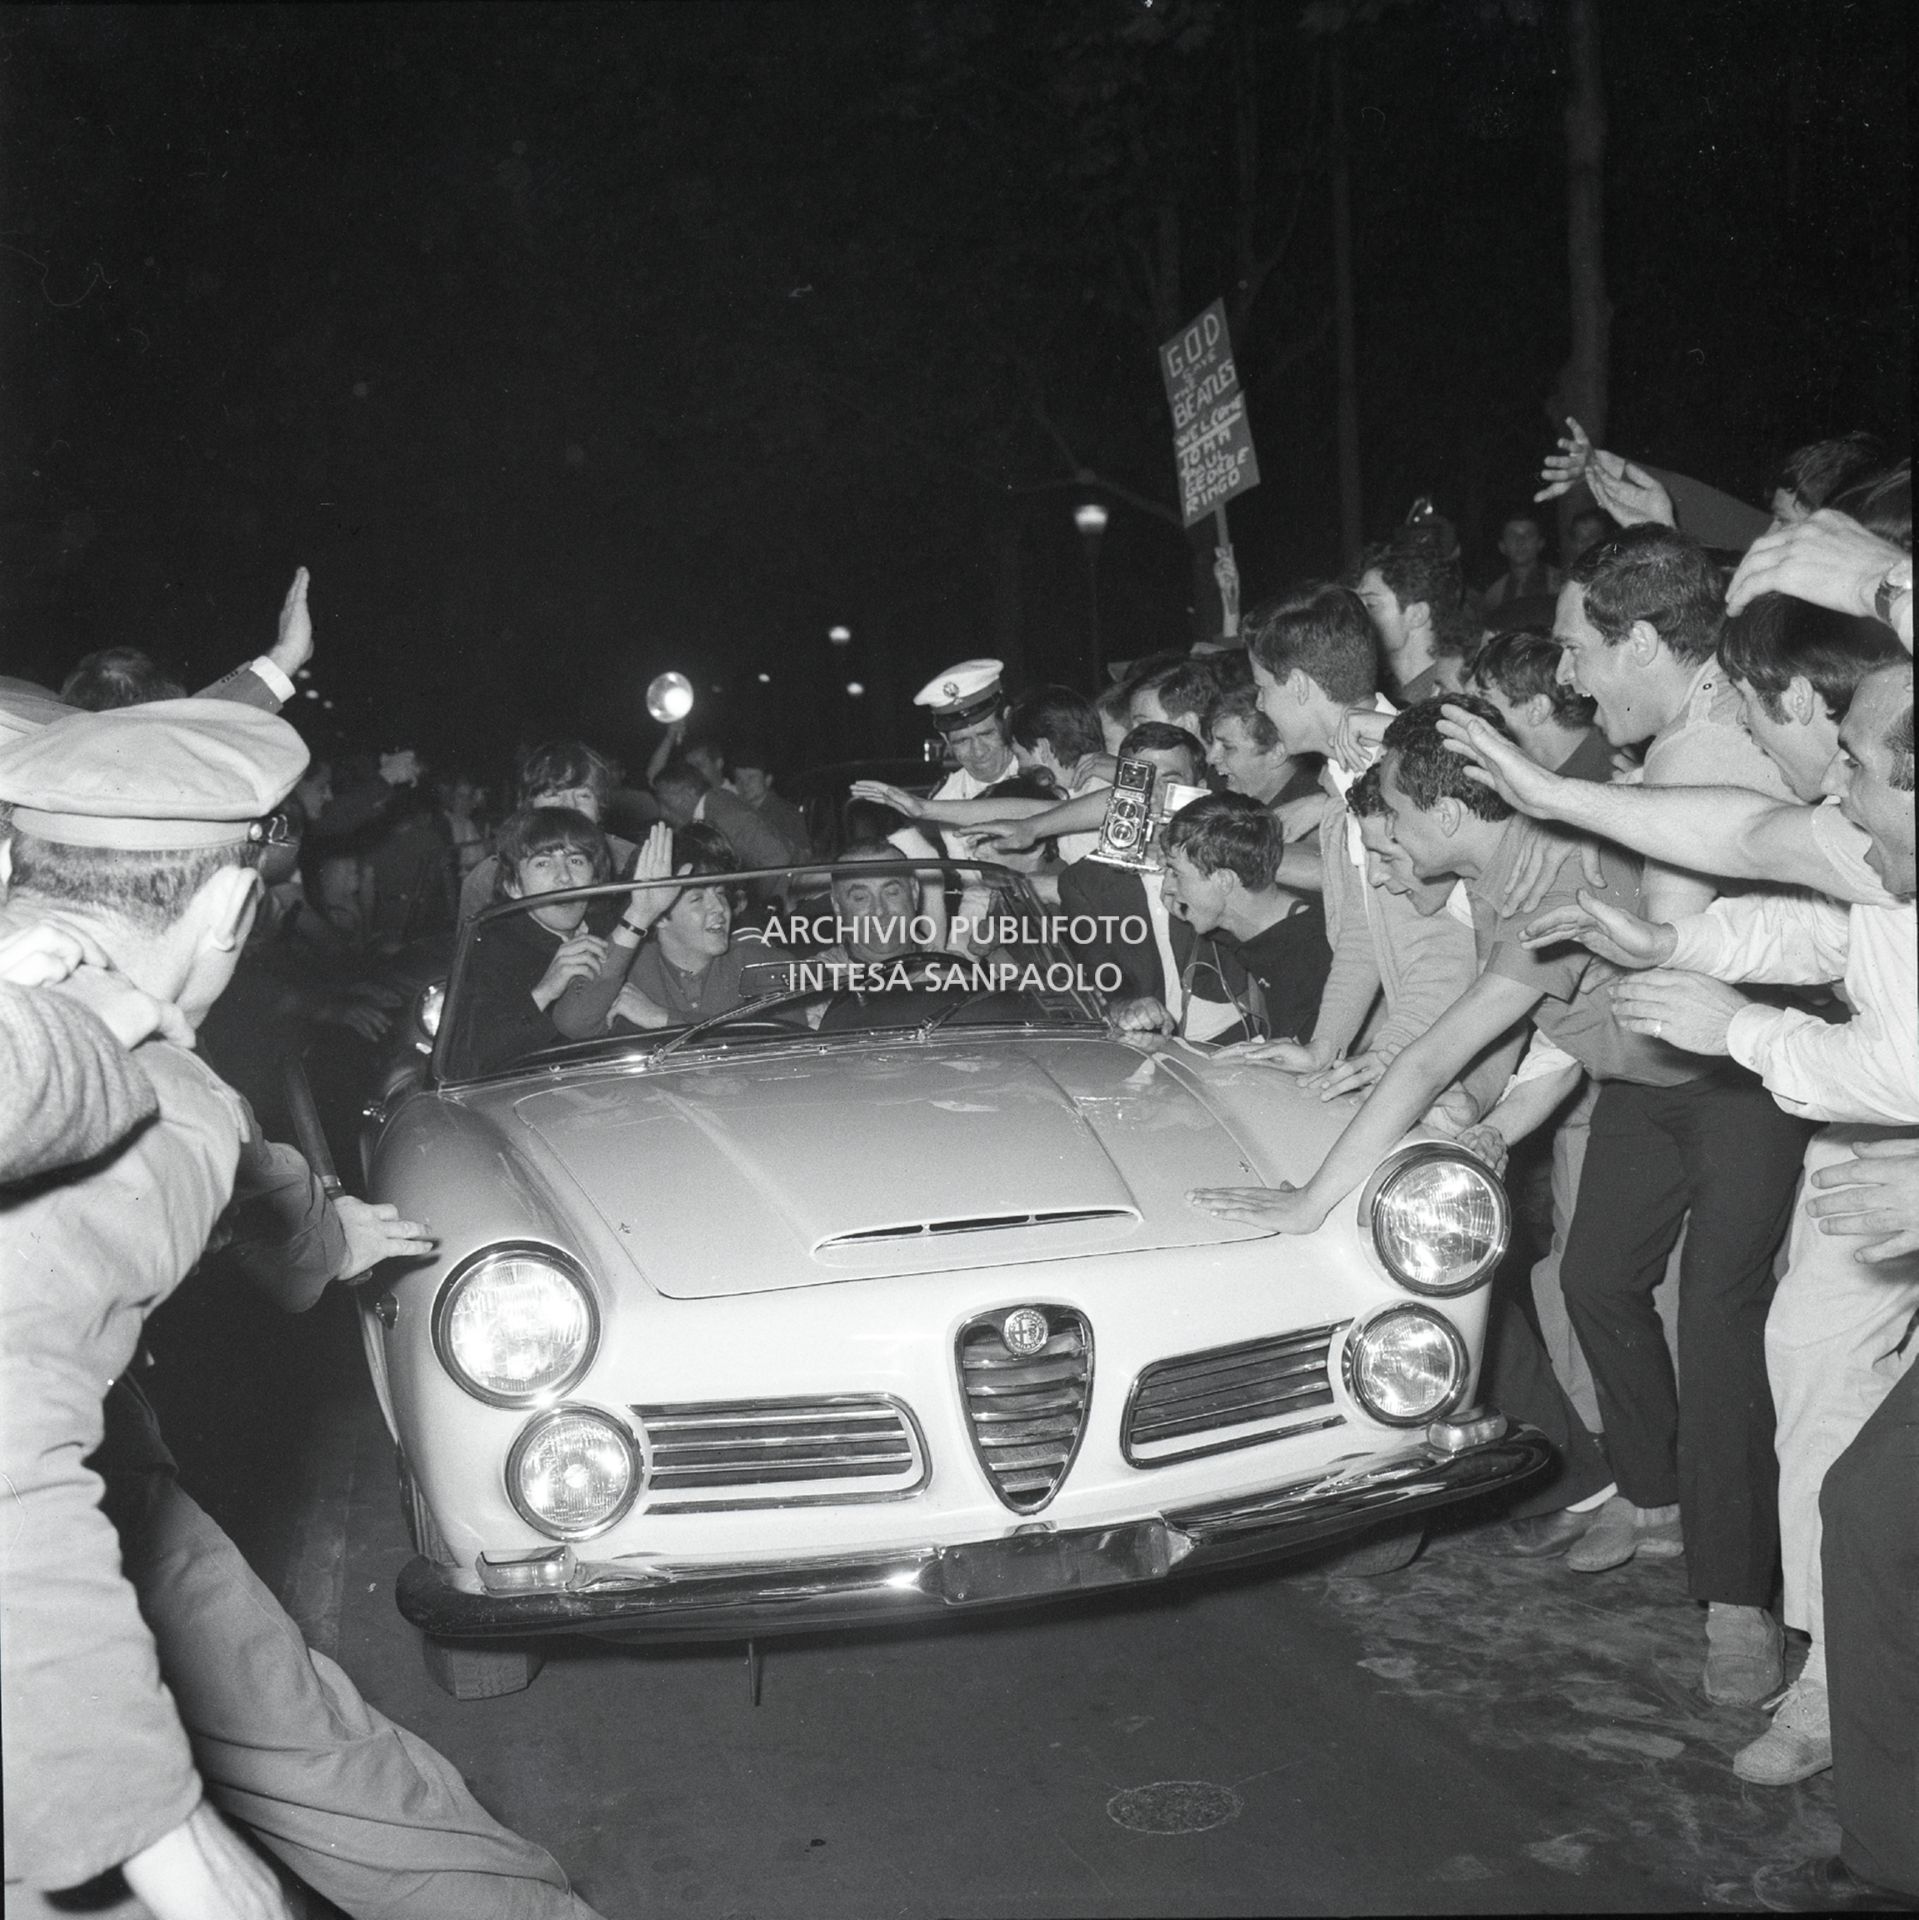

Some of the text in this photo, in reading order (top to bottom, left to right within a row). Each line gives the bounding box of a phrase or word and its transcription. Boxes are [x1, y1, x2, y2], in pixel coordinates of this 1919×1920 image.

[1166, 313, 1221, 378] GOD
[1173, 358, 1238, 430] BEATLES
[1175, 392, 1243, 447] WELCOME
[1186, 467, 1242, 519] RINGO
